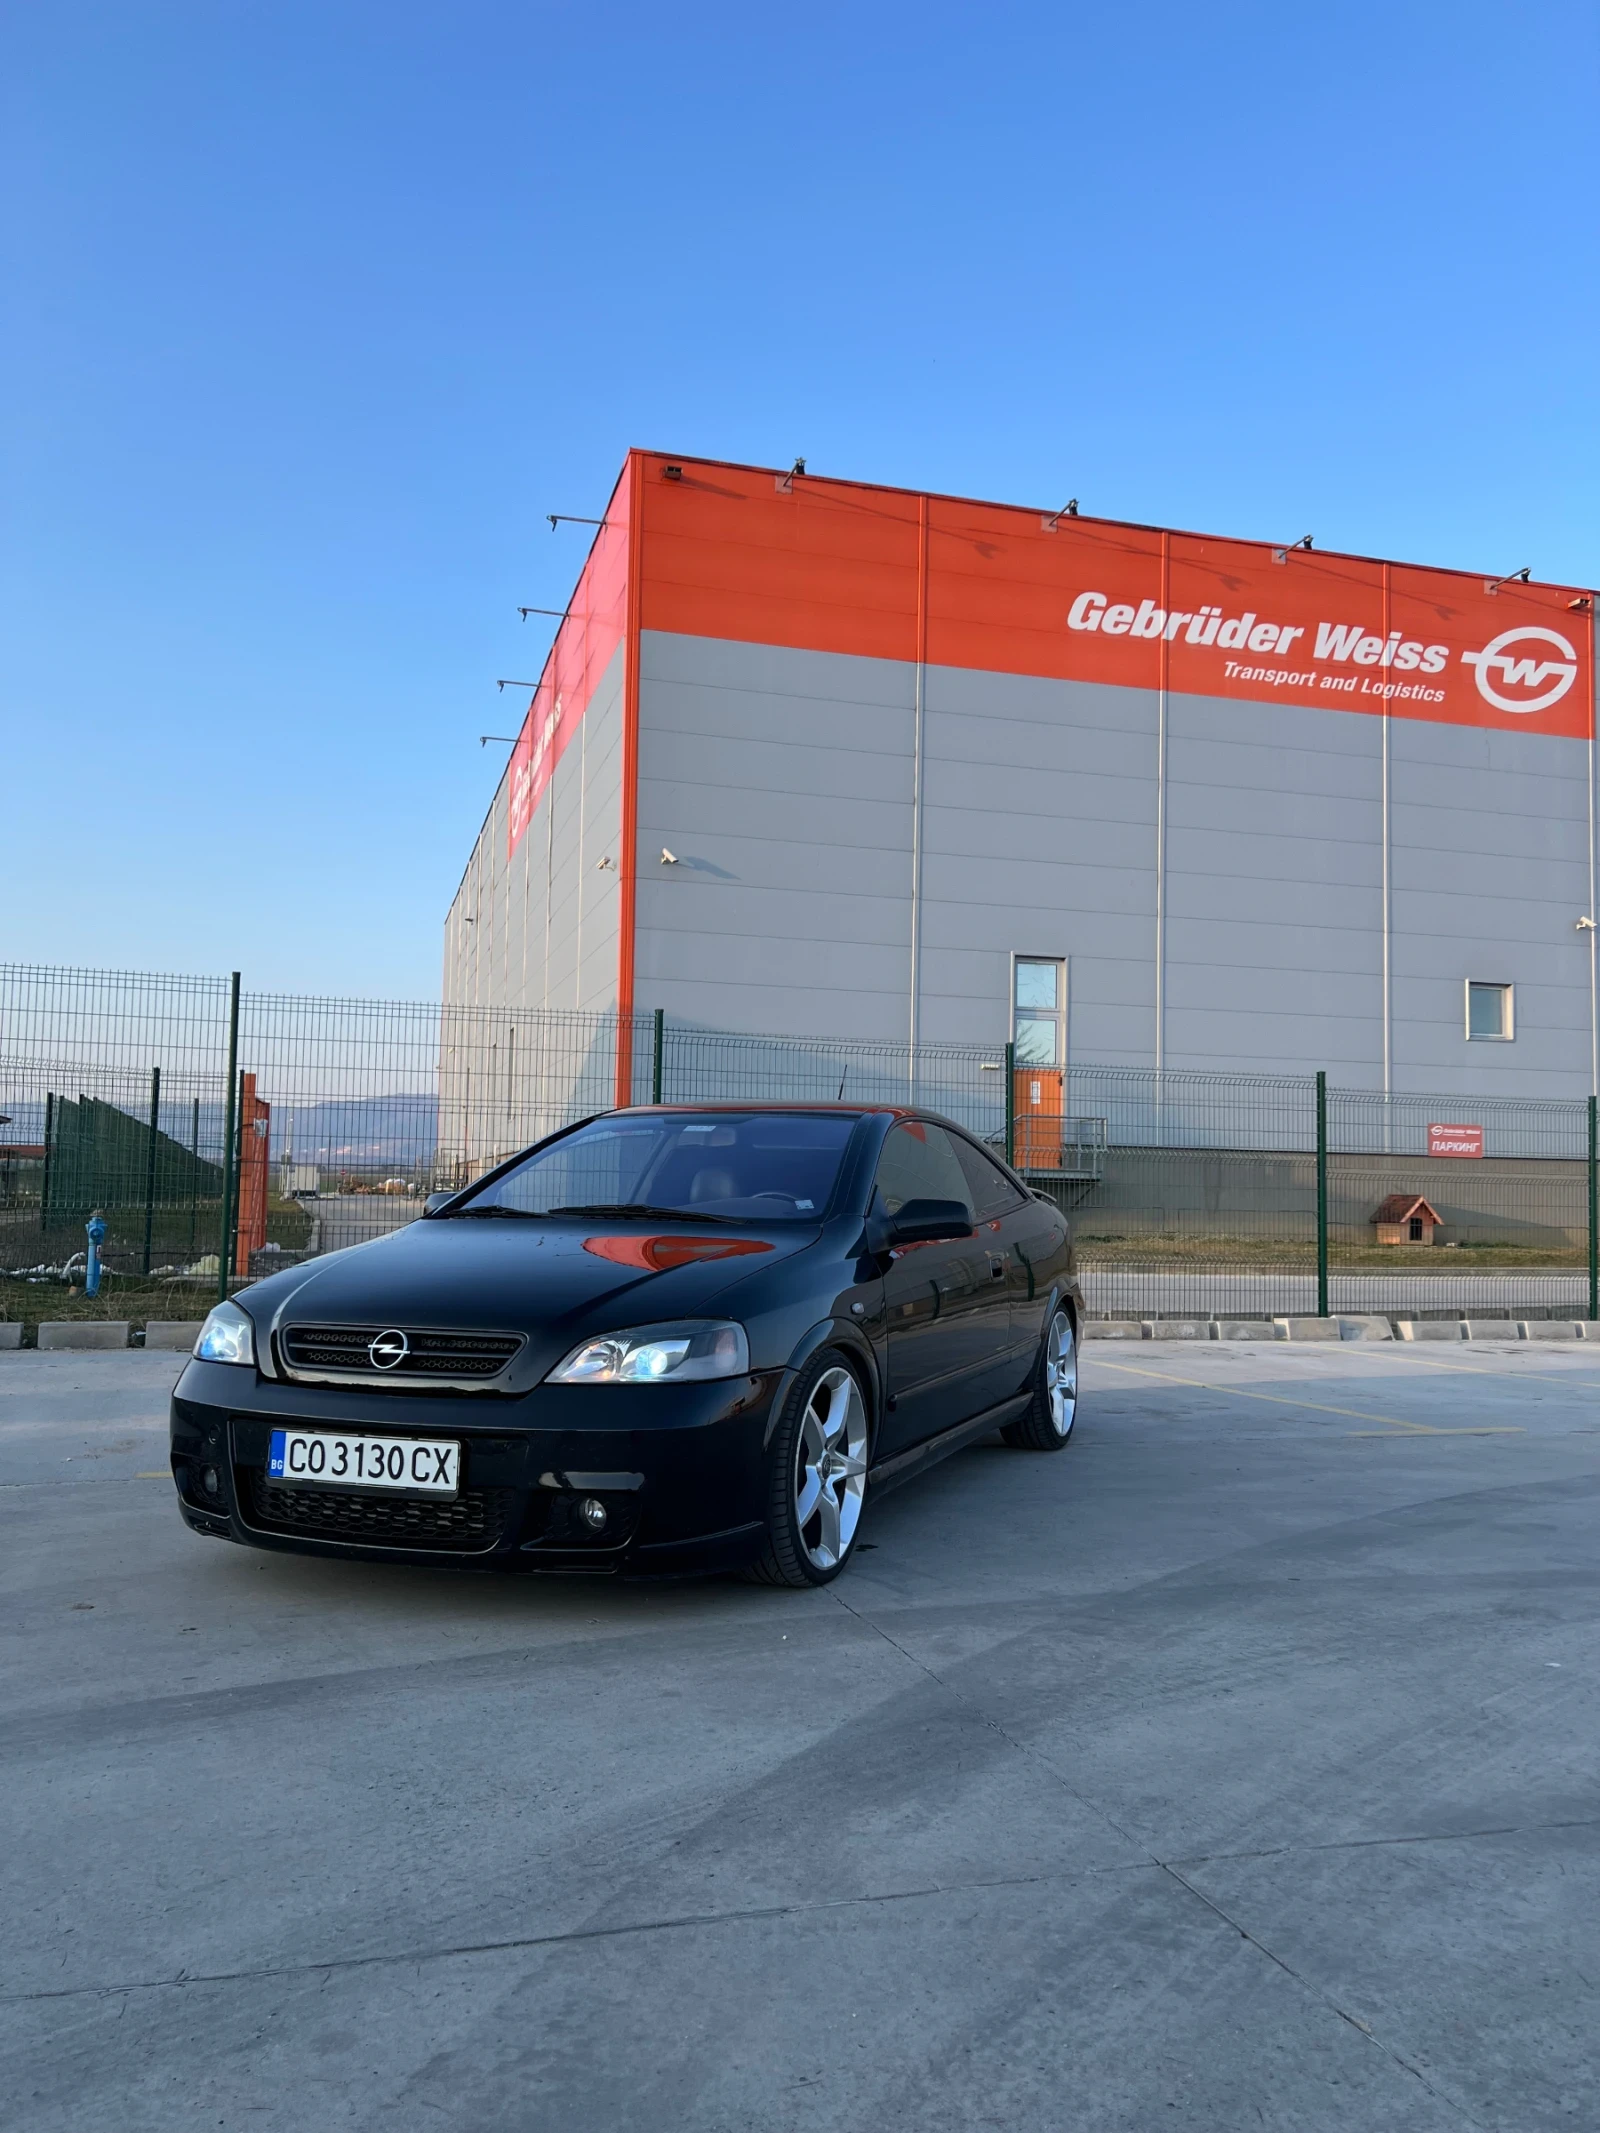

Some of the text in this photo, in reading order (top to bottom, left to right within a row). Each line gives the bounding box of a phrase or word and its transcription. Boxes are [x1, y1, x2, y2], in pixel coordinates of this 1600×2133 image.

[1067, 592, 1449, 674] Gebrüder Weiss
[1224, 661, 1445, 702] Transport and Logistics
[1432, 1141, 1480, 1153] ПАРКИНГ
[271, 1459, 283, 1470] BG
